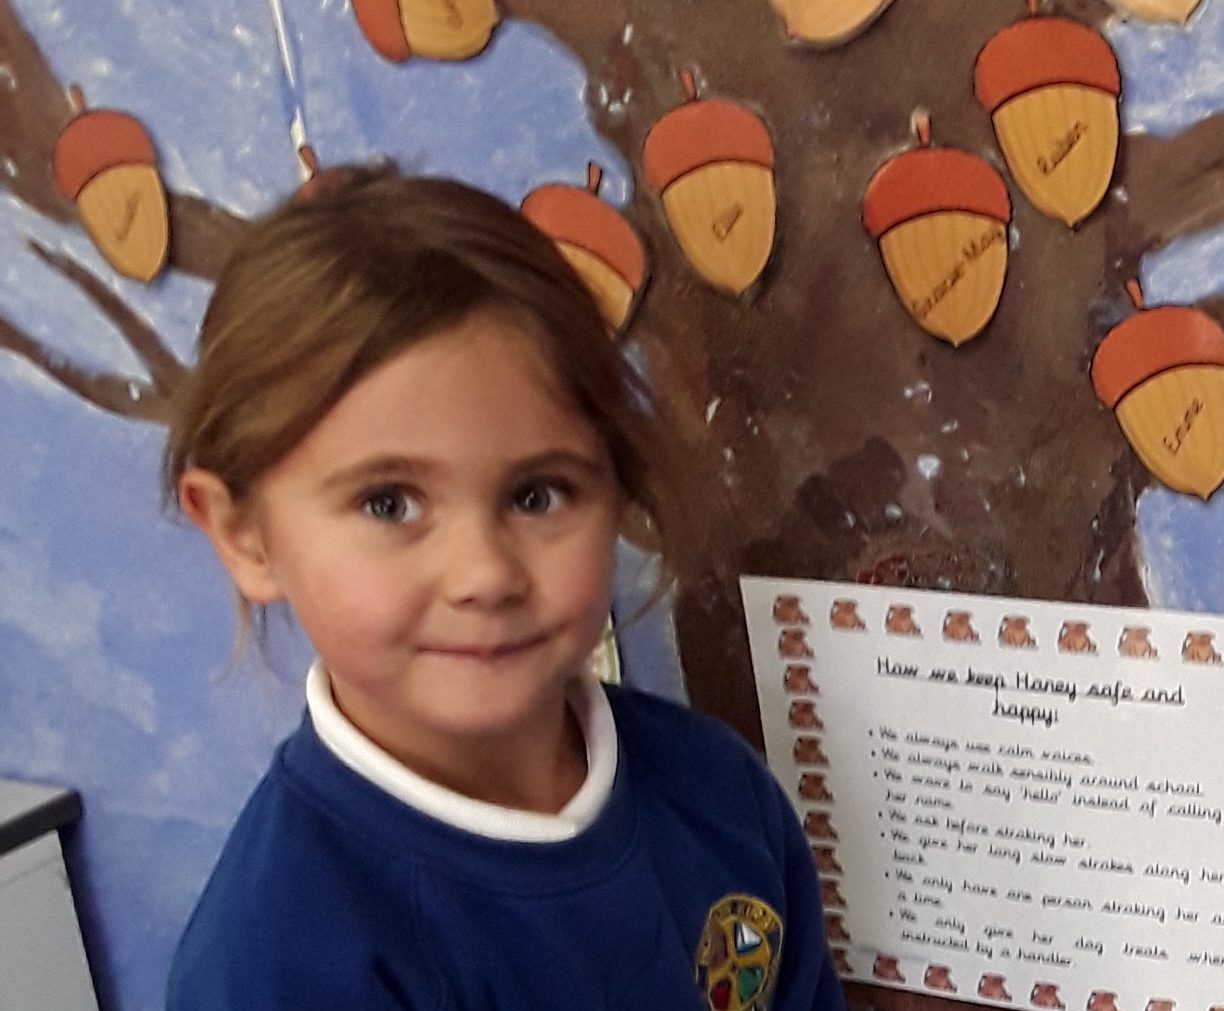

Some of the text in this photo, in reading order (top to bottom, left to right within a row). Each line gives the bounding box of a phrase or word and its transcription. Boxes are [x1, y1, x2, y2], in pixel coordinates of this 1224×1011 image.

[876, 656, 1186, 706] How we keep Honey safe and
[879, 726, 897, 740] We
[906, 731, 959, 752] always
[965, 741, 991, 752] use
[998, 743, 1033, 757] calm
[882, 746, 899, 760] We
[908, 752, 960, 773] always
[968, 761, 1001, 775] walk
[1010, 768, 1072, 789] sensibly
[1080, 775, 1139, 791] around
[884, 767, 902, 781] We
[912, 775, 950, 788] wave
[959, 779, 973, 791] to
[983, 783, 1010, 801] say
[1072, 793, 1130, 811] instead
[1139, 799, 1156, 818] of
[1167, 804, 1222, 825] calling
[886, 790, 906, 802] her
[889, 808, 906, 822] We
[914, 815, 938, 826] ask
[947, 817, 989, 835] before
[996, 827, 1055, 848] stroking
[891, 829, 1224, 885] We give her long slow strokes along her
[896, 868, 912, 881] We
[922, 876, 952, 893] only
[963, 879, 997, 895] have
[1007, 888, 1032, 900] one
[1043, 895, 1092, 909] person
[1102, 900, 1165, 923] stroking
[1177, 906, 1199, 921] her
[898, 891, 906, 900] a
[899, 908, 917, 921] We
[936, 916, 966, 935] only
[983, 926, 1014, 940] give
[1032, 930, 1053, 944] her
[1075, 936, 1104, 957] dog
[1123, 943, 1170, 960] treats
[902, 929, 968, 951] instructed
[976, 941, 993, 959] by
[1001, 947, 1010, 957] a
